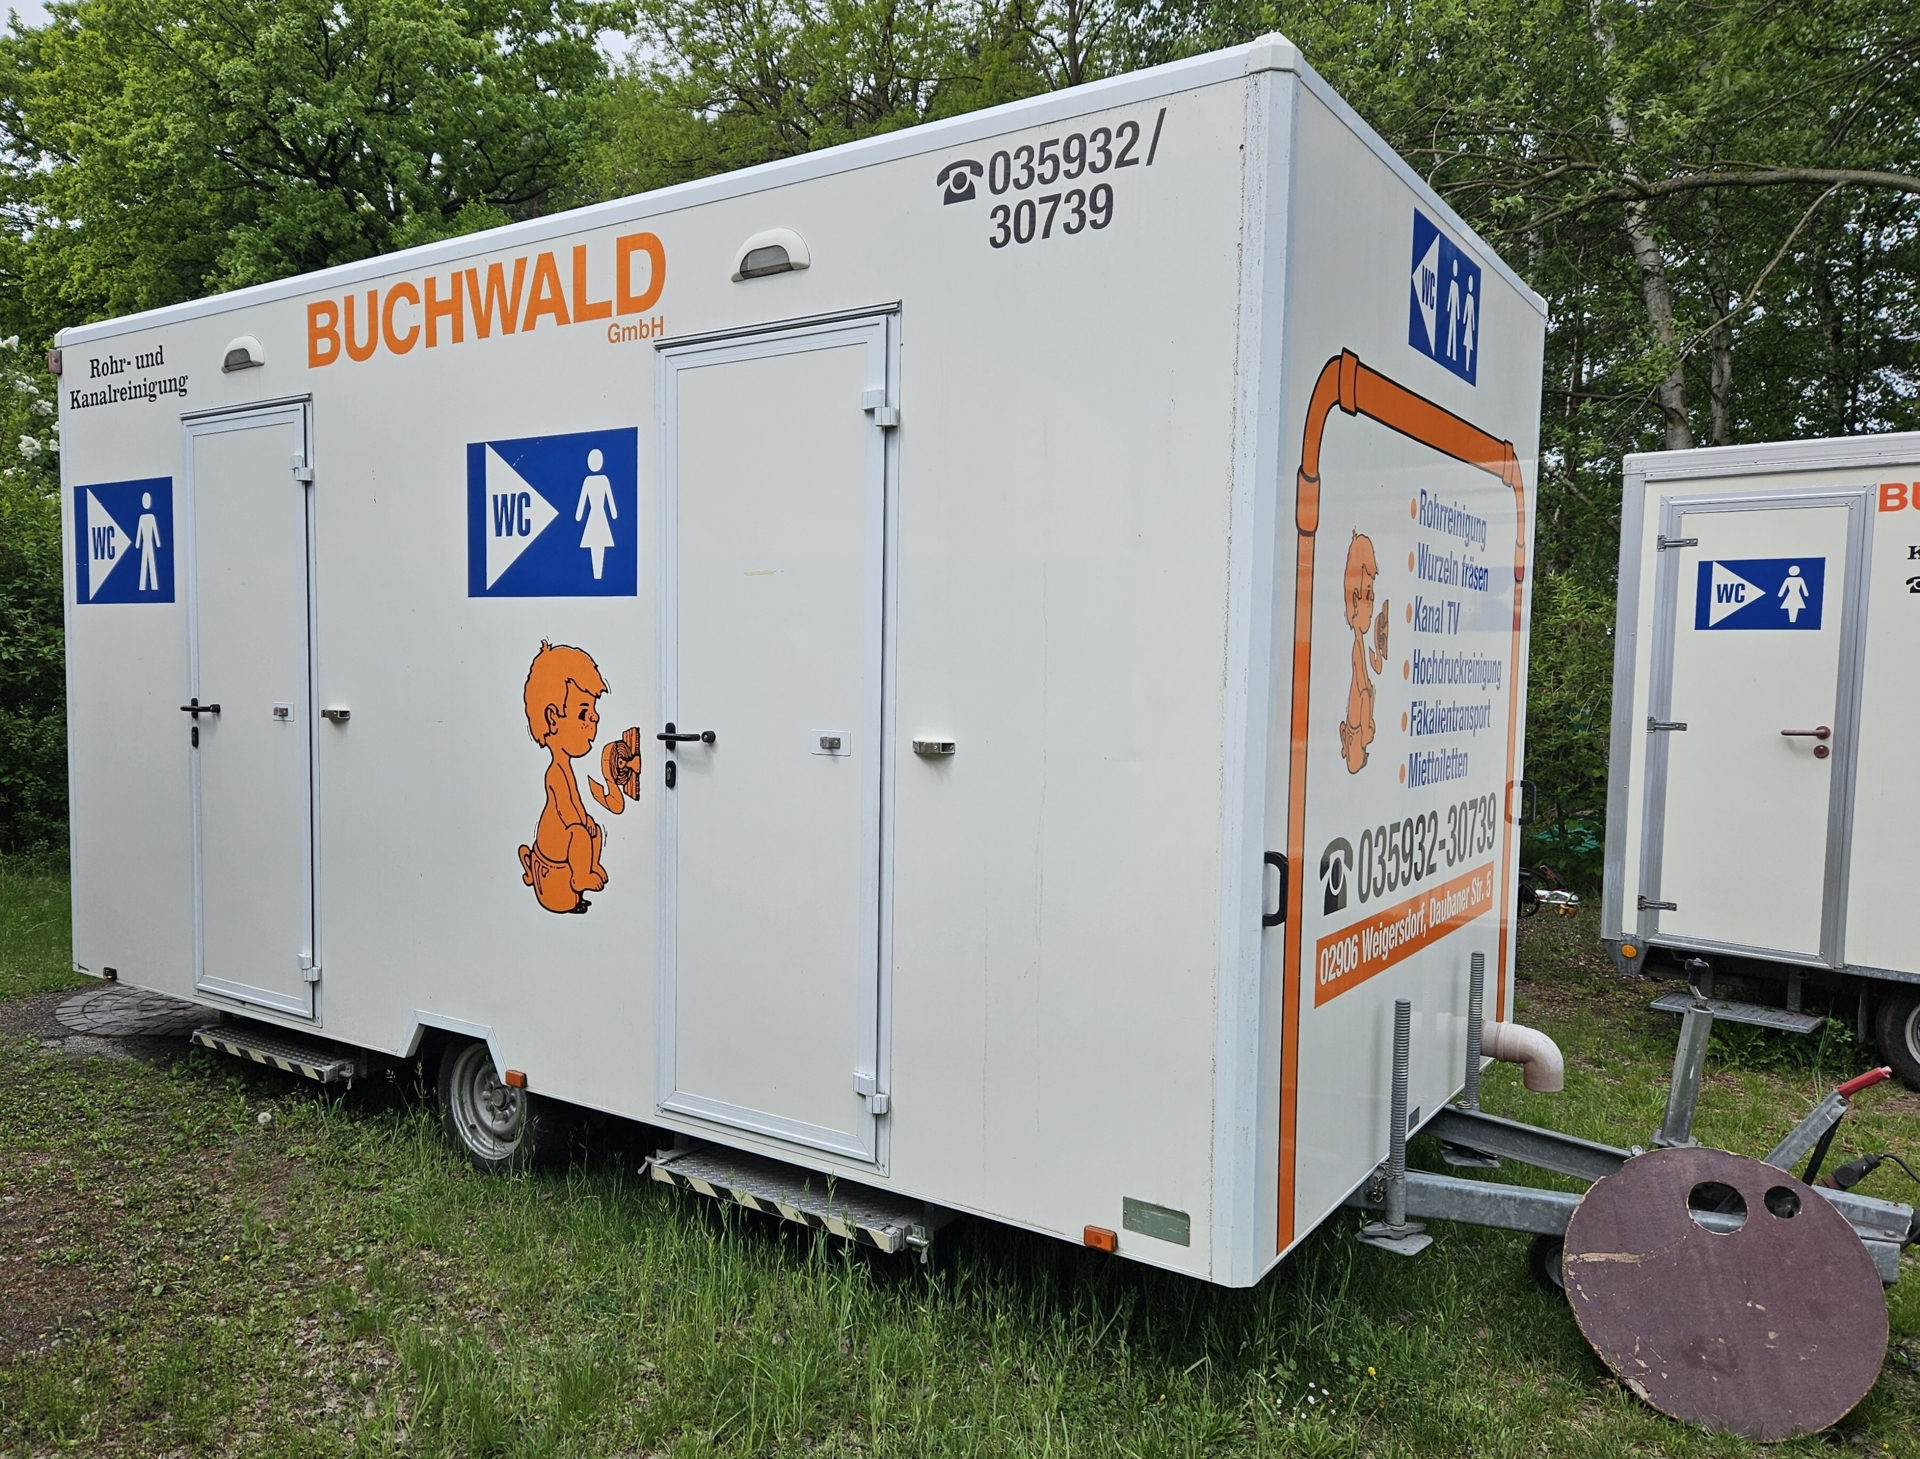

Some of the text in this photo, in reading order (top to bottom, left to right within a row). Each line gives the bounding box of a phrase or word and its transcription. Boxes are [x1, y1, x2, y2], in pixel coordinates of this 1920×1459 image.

[988, 107, 1167, 195] 035932/
[989, 183, 1114, 249] 30739
[307, 231, 666, 369] BUCHWALD
[1421, 265, 1435, 310] WC
[607, 316, 664, 344] GmbH
[89, 345, 165, 379] Rohr- und
[70, 374, 189, 410] Kanalreinigung
[492, 491, 531, 537] WC
[1419, 488, 1487, 552] Rohrreinigung
[92, 525, 115, 560] WC
[1418, 542, 1489, 592] Wurzeln fräsen
[1414, 595, 1461, 635] Kanal TV
[1716, 583, 1746, 604] WC
[1412, 649, 1502, 691] Hochdruckreinigung
[1410, 698, 1491, 737] Fäkalientransport
[1408, 747, 1468, 789] Miettoiletten
[1358, 792, 1496, 904] 035932-30739
[1320, 870, 1492, 986] 02906 Weigersdorf, Daubaner Str. 5
